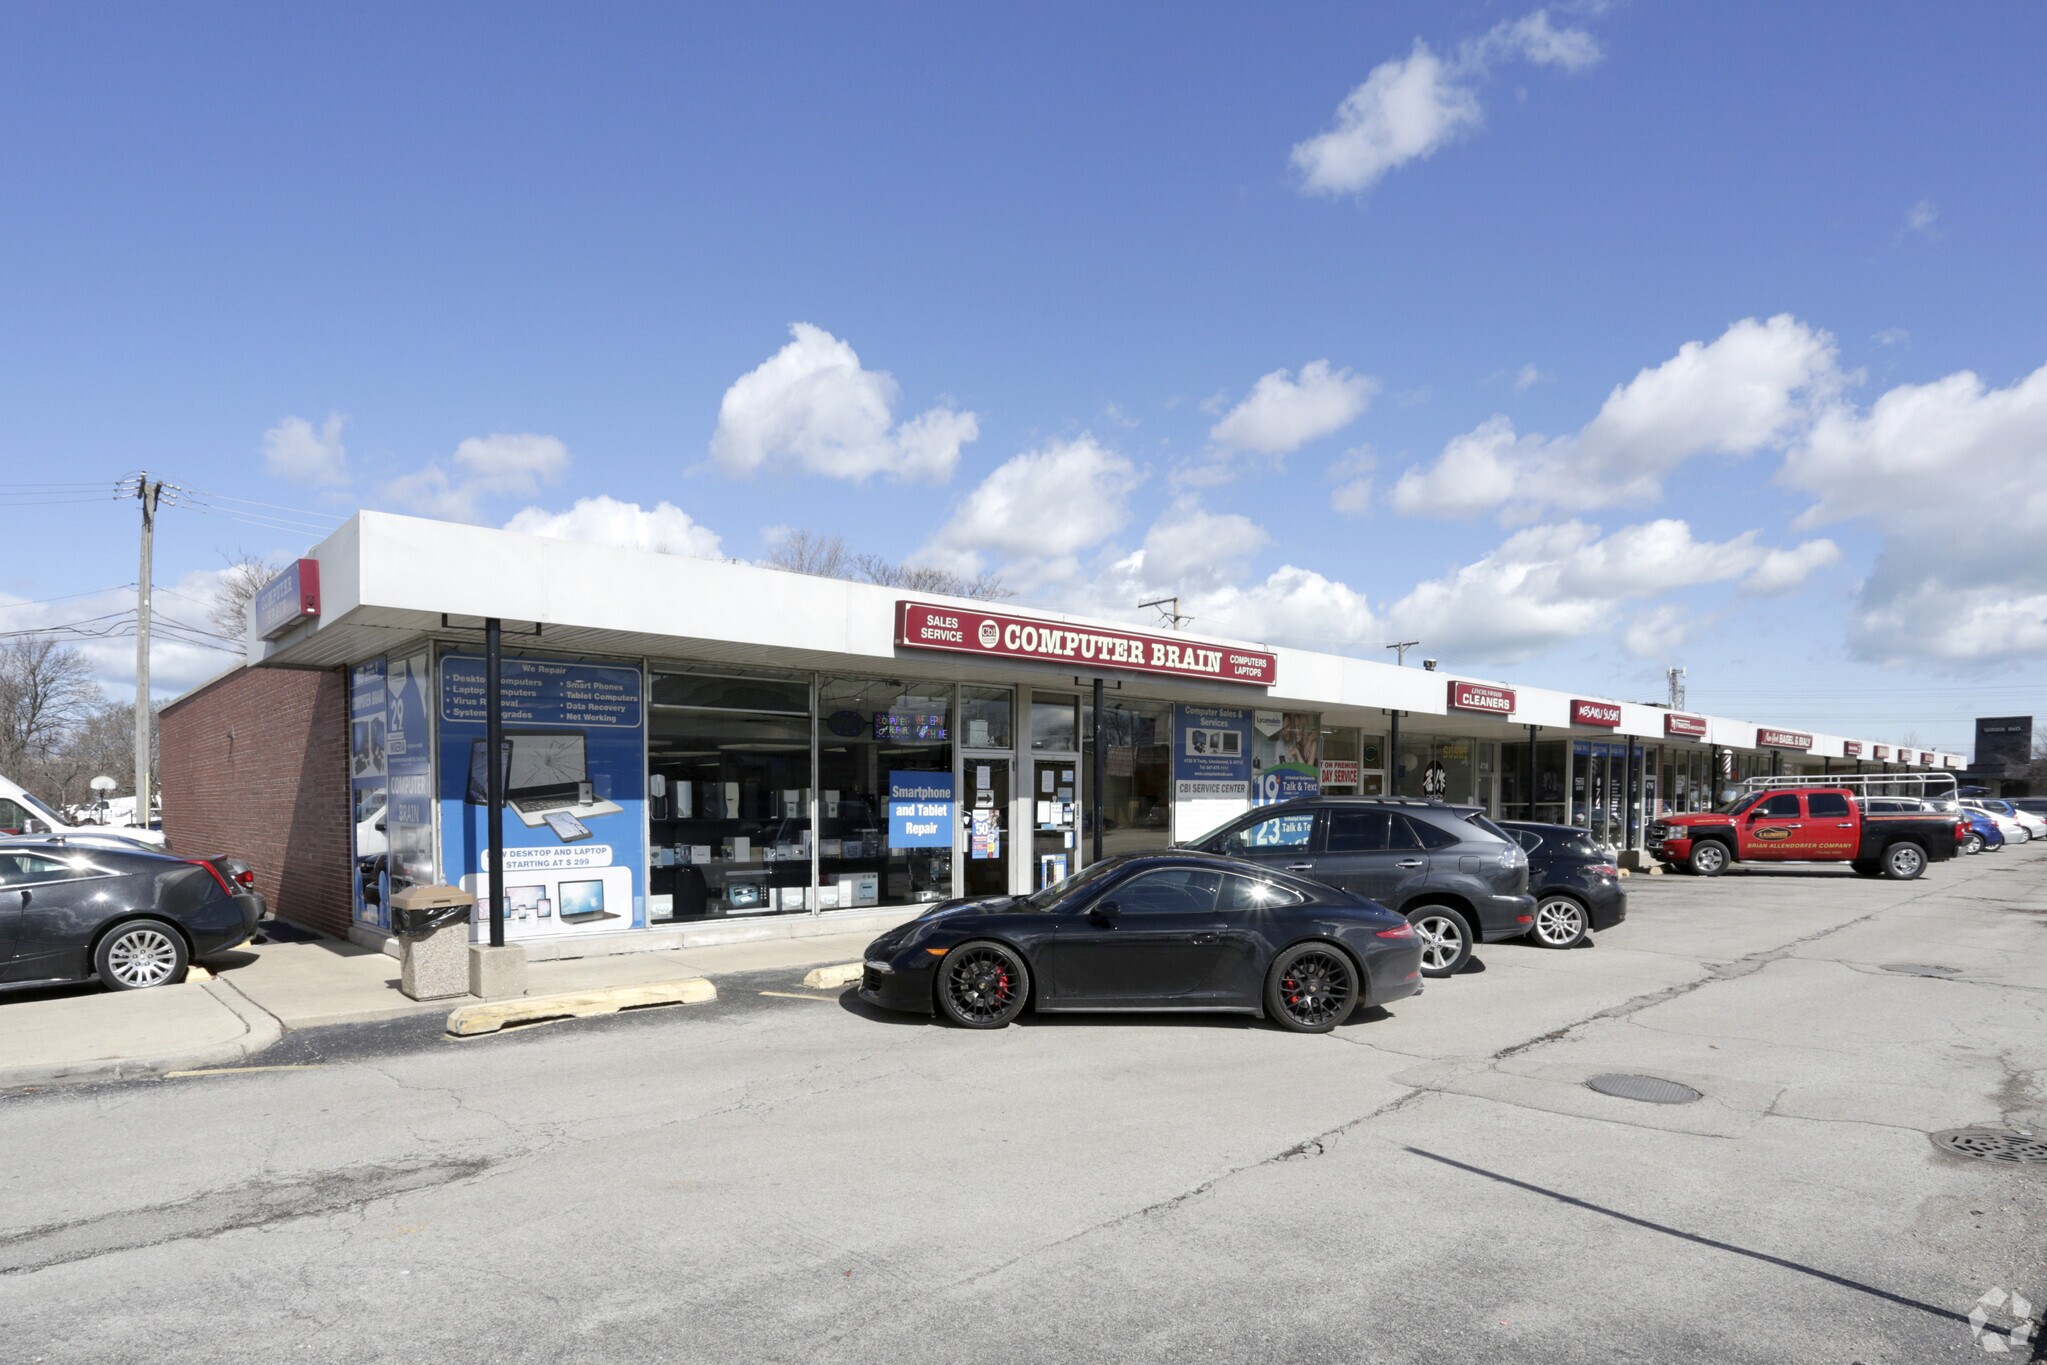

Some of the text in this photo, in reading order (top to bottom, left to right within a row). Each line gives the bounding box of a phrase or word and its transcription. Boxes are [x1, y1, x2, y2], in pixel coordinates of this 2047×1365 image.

[927, 615, 958, 629] SALES
[921, 627, 963, 642] SERVICE
[1004, 624, 1222, 673] COMPUTER BRAIN
[1229, 654, 1267, 668] COMPUTERS
[522, 664, 566, 675] We Repair
[1234, 666, 1262, 677] LAPTOPS
[452, 674, 543, 686] Deskto omputers
[566, 680, 624, 691] Smart Phones
[452, 685, 537, 697] Laptop mputers
[566, 691, 638, 702] Tablet Computers
[452, 697, 518, 707] Virus Roval
[566, 702, 626, 713] Data Recovery
[1462, 693, 1510, 710] CLEANERS
[391, 698, 404, 731] 29
[452, 708, 533, 719] System grades
[566, 712, 617, 723] Net Working
[1185, 706, 1218, 717] Computer
[1219, 708, 1237, 718] Sales
[1200, 717, 1229, 727] Services
[1442, 745, 1468, 759] SUSHI
[1322, 770, 1357, 783] DAY SERVICE
[391, 776, 426, 794] COMPUTER
[1179, 783, 1246, 793] CBI SERVICE CENTER
[1258, 774, 1279, 806] 19
[1282, 781, 1318, 792] Talk & Text
[892, 785, 951, 800] Smartphone
[399, 803, 420, 823] BRAIN
[896, 803, 947, 817] and Tablet
[905, 822, 938, 837] Repair
[975, 821, 989, 836] 50
[1256, 817, 1281, 845] 23
[1282, 822, 1311, 833] Talk & Te
[509, 849, 552, 858] DESKTOP
[553, 848, 572, 856] AND
[574, 847, 607, 855] LAPTOP
[505, 860, 550, 869] STARTING
[552, 859, 564, 867] AT
